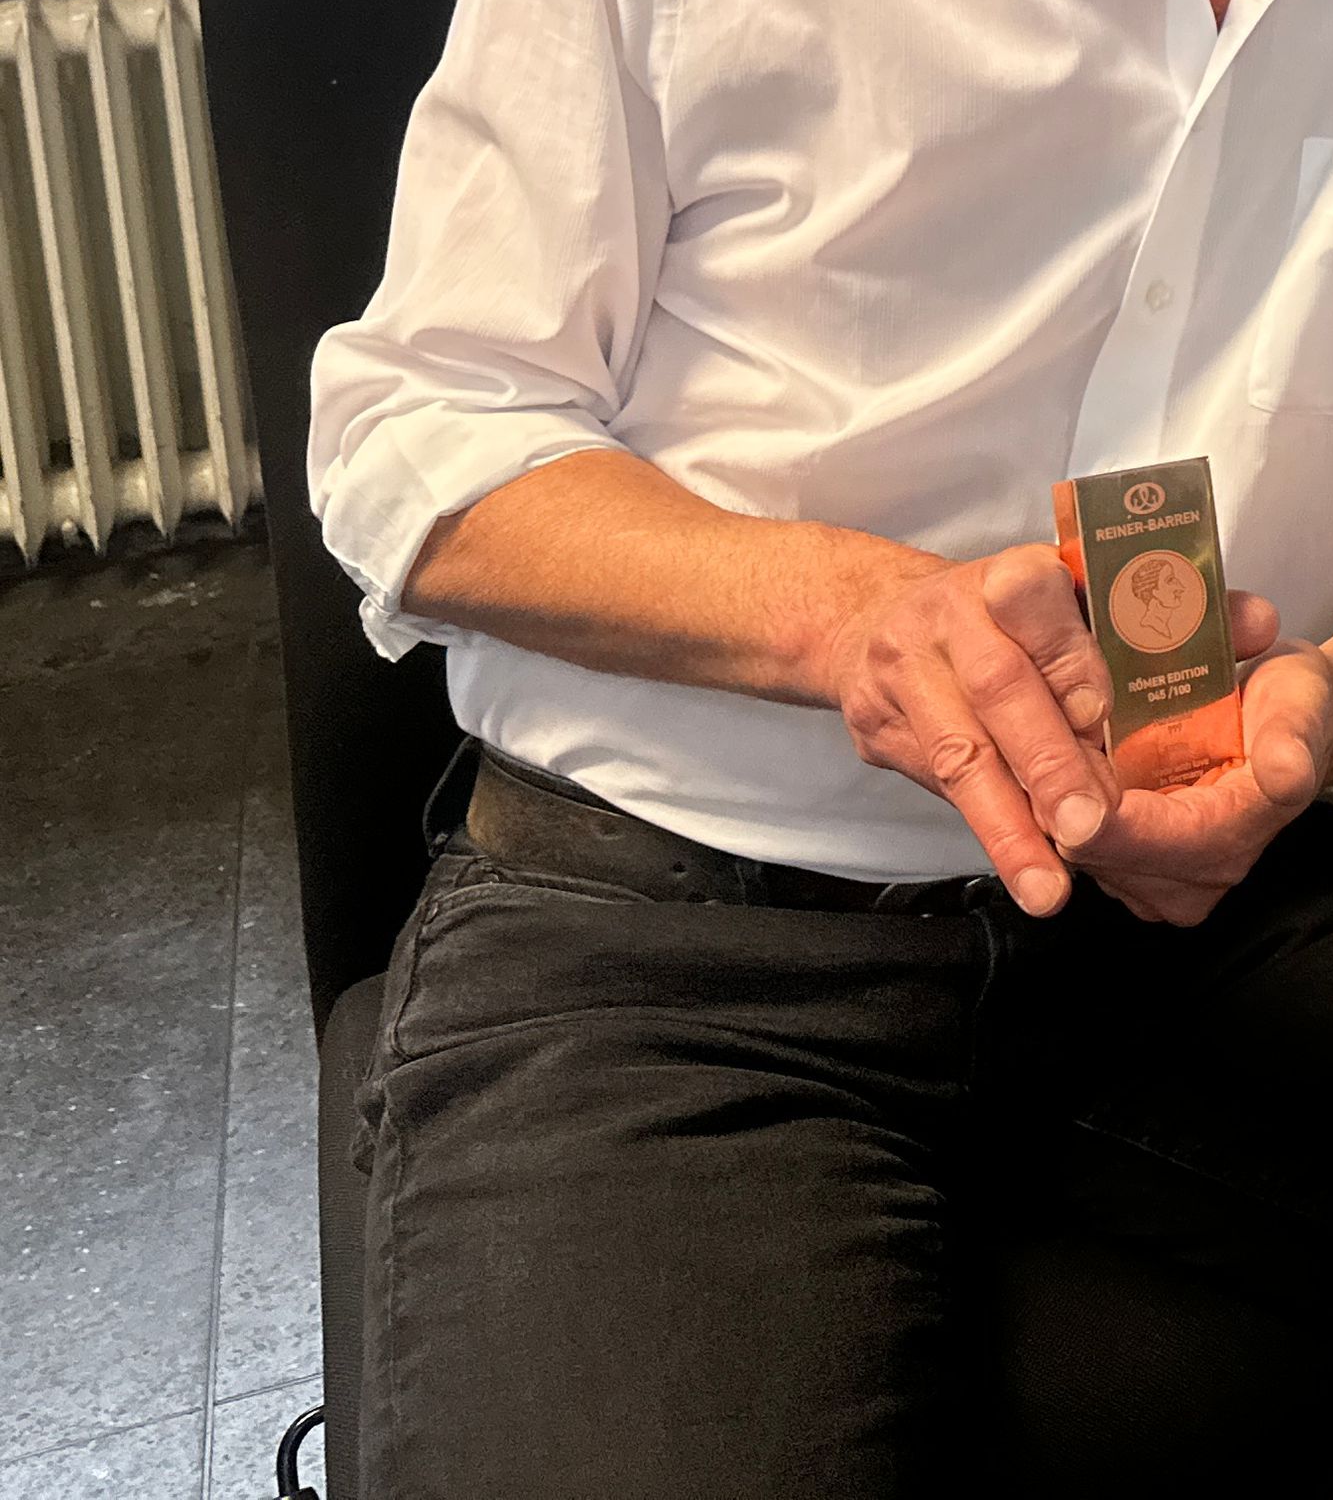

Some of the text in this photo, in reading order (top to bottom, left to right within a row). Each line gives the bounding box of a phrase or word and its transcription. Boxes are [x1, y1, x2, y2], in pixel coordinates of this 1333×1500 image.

[1095, 509, 1201, 542] REINER-BARREN
[1128, 664, 1209, 693] RÖMER EDITION
